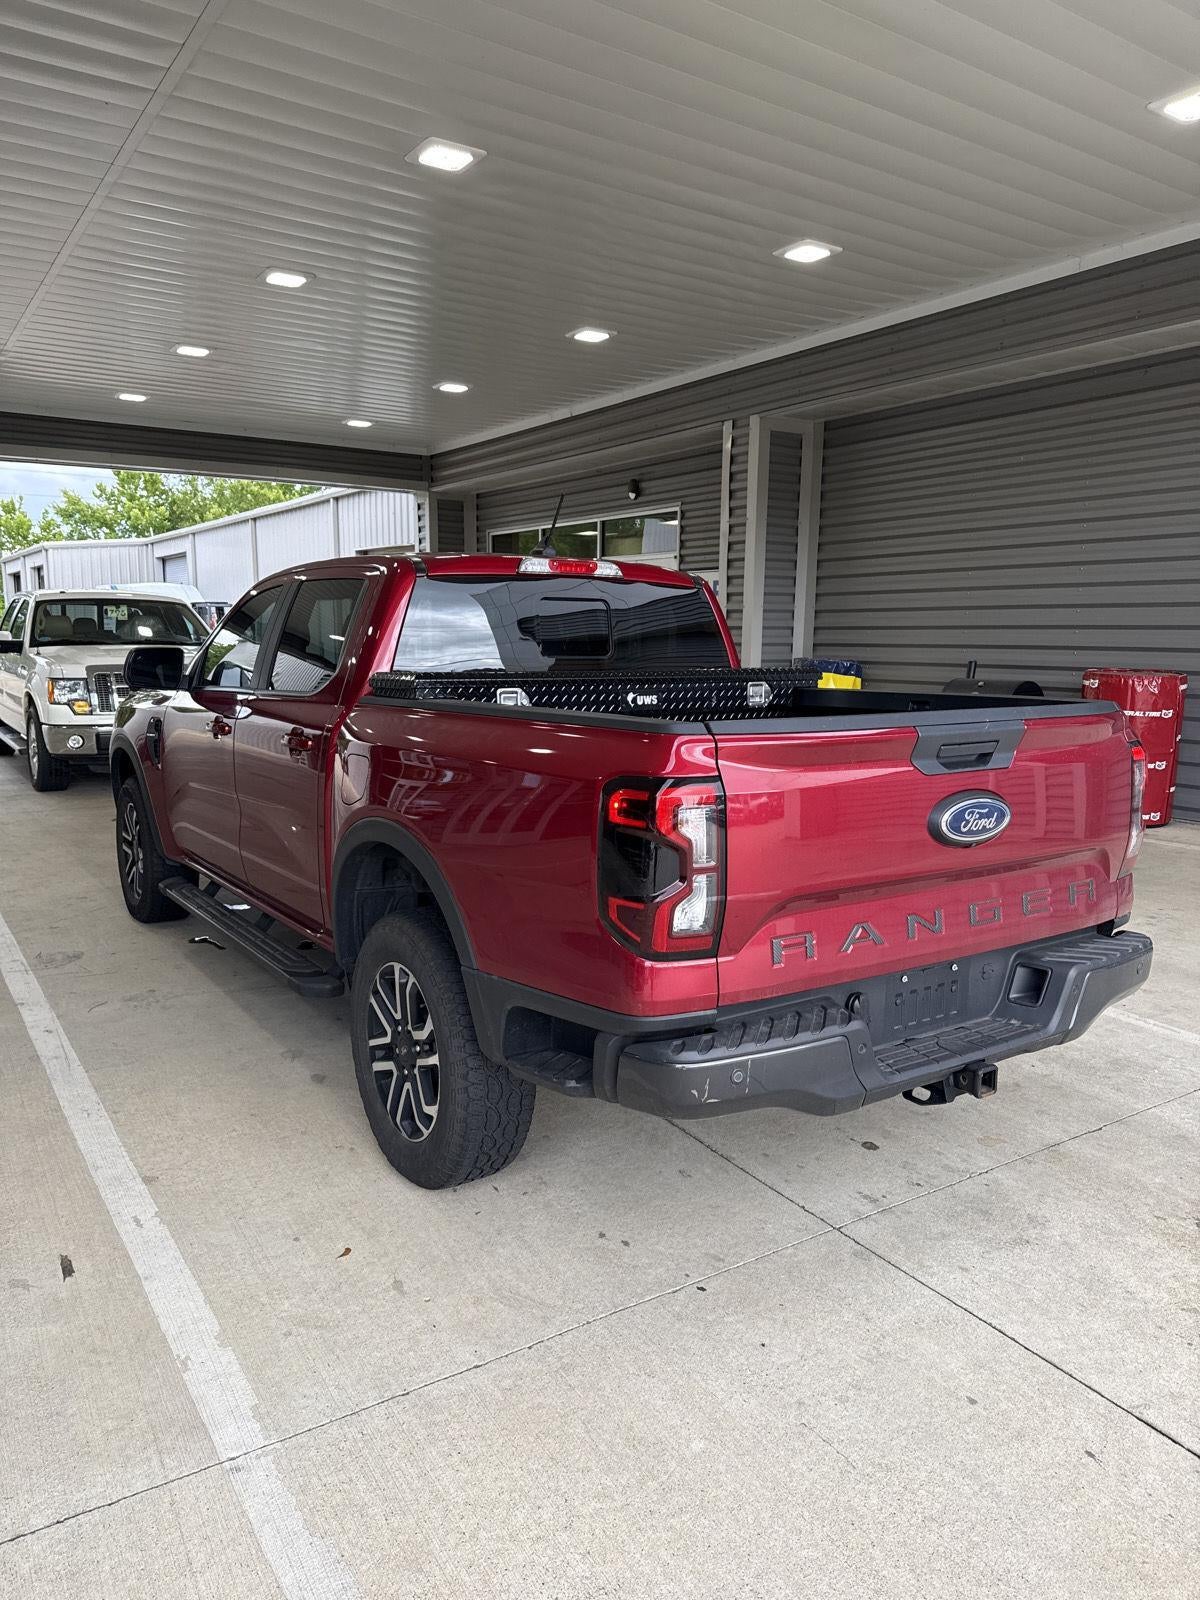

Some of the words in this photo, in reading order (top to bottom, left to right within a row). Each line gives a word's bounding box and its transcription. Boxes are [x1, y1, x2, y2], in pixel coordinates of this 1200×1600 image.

[636, 694, 658, 706] UWS
[960, 808, 997, 832] Ford
[771, 878, 1097, 968] RANGER
